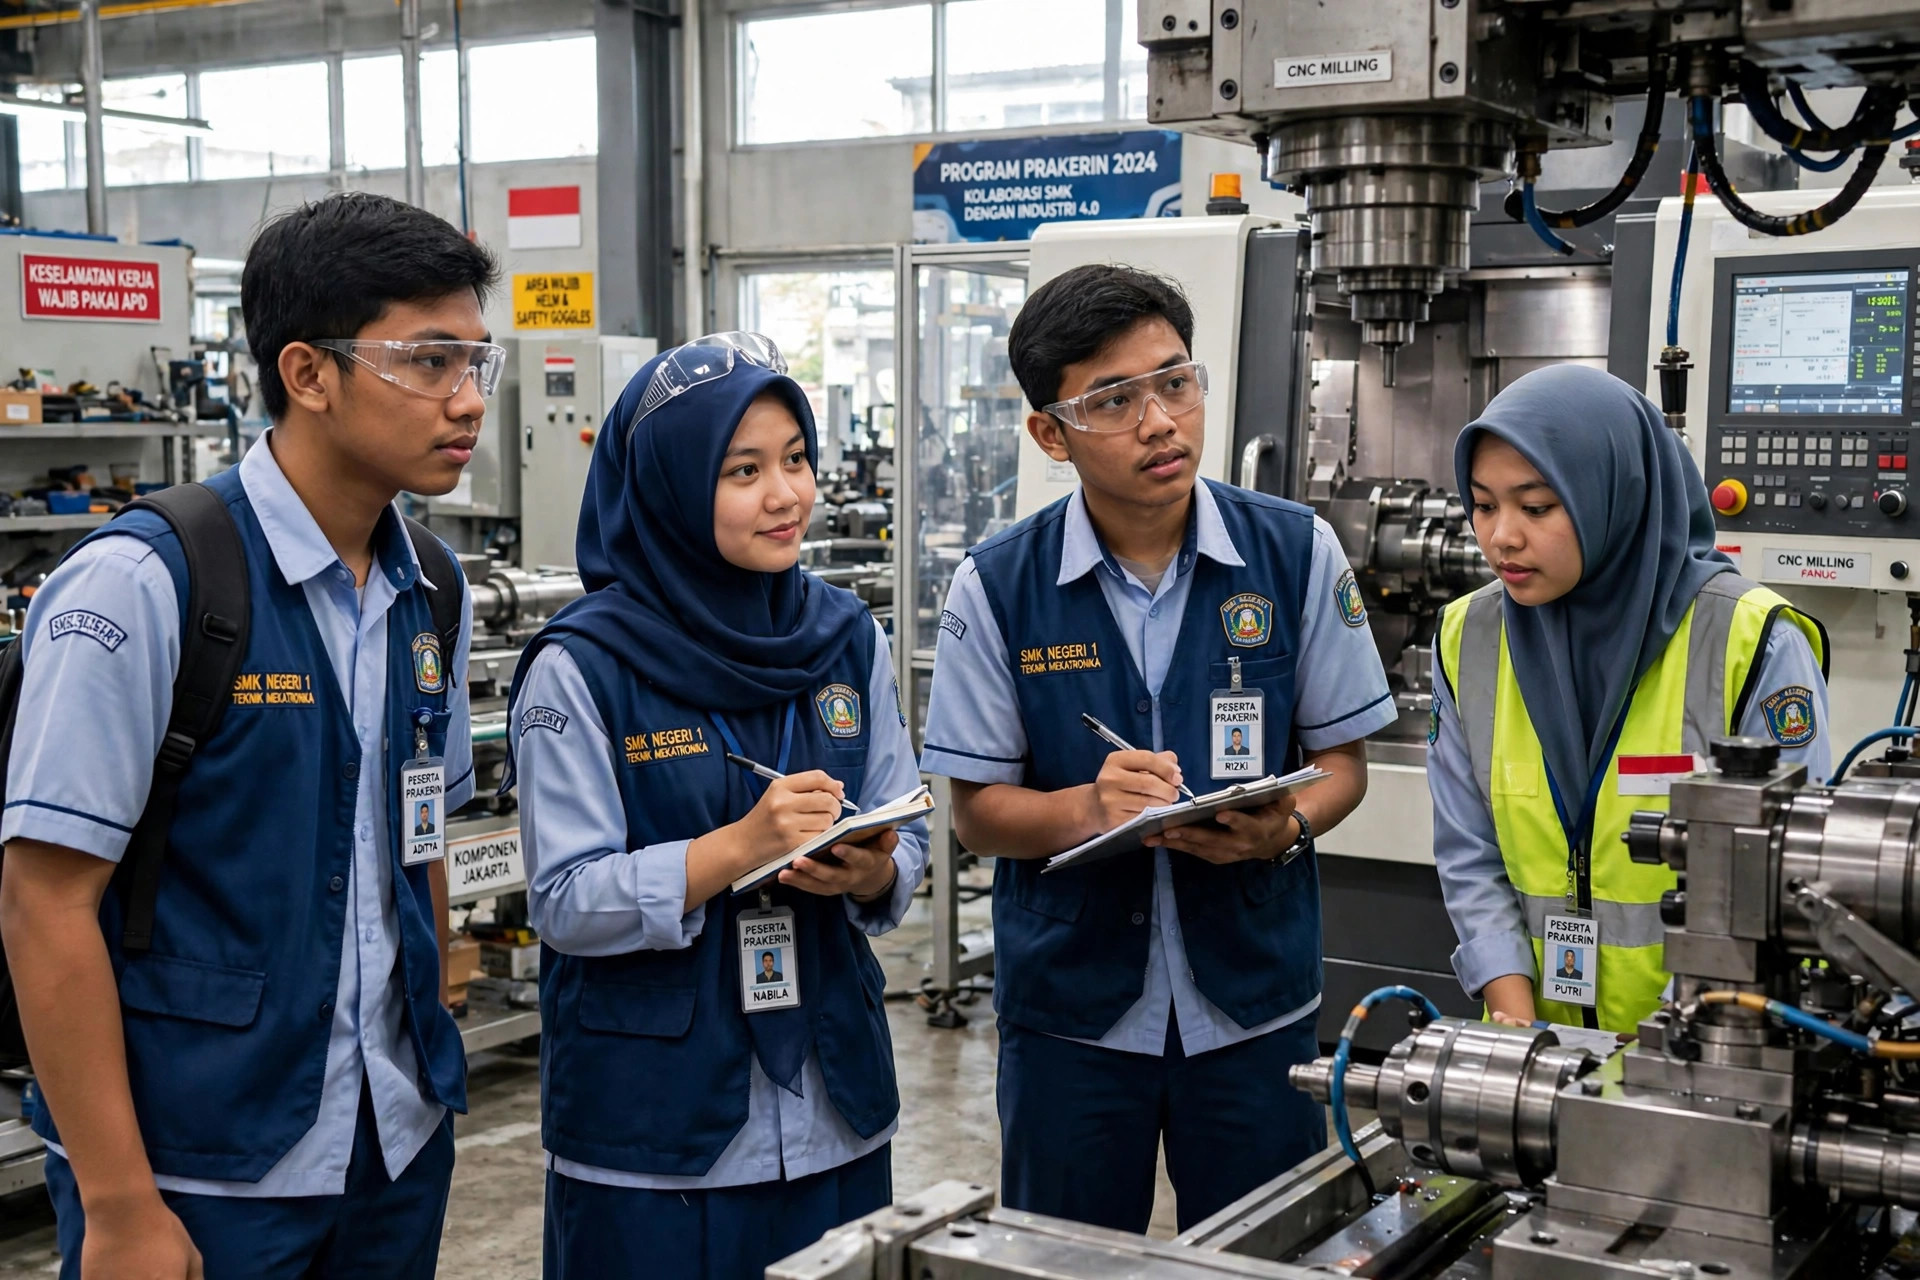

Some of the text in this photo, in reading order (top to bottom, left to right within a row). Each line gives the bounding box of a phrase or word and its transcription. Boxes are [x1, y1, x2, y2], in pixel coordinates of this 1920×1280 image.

[1287, 58, 1378, 78] CNC MILLING
[940, 150, 1158, 183] PROGRAM PRAKERIN 2024
[963, 184, 1073, 204] KOLABORASI SMK
[963, 200, 1100, 222] DENGAN INDUSTRI 4.0
[29, 263, 155, 290] KESELAMATAN KERJA
[37, 288, 148, 312] WAJIB PAKAI APD
[1777, 554, 1855, 569] CNC MILLING
[1801, 568, 1837, 580] FANUC
[1020, 641, 1097, 663] SMK NEGERI 1
[233, 673, 311, 691] SMK NEGERI 1
[232, 691, 264, 705] TEKNIK
[1216, 702, 1256, 712] PESERTA
[1214, 712, 1259, 723] PRAKERIN
[624, 726, 703, 752] SMK NEGERI 1
[1224, 761, 1249, 771] RIZKI
[407, 772, 440, 786] PESERTA
[406, 785, 443, 799] PRAKERIN
[454, 840, 518, 868] KOMPONEN
[462, 861, 511, 885] JAKARTA
[745, 922, 787, 936] PESERTA
[1550, 919, 1592, 934] PESERTA
[743, 933, 791, 948] PRAKERIN
[1547, 931, 1594, 945] PRAKERIN
[753, 987, 789, 1003] NABILA
[1554, 983, 1582, 997] PUTRI
